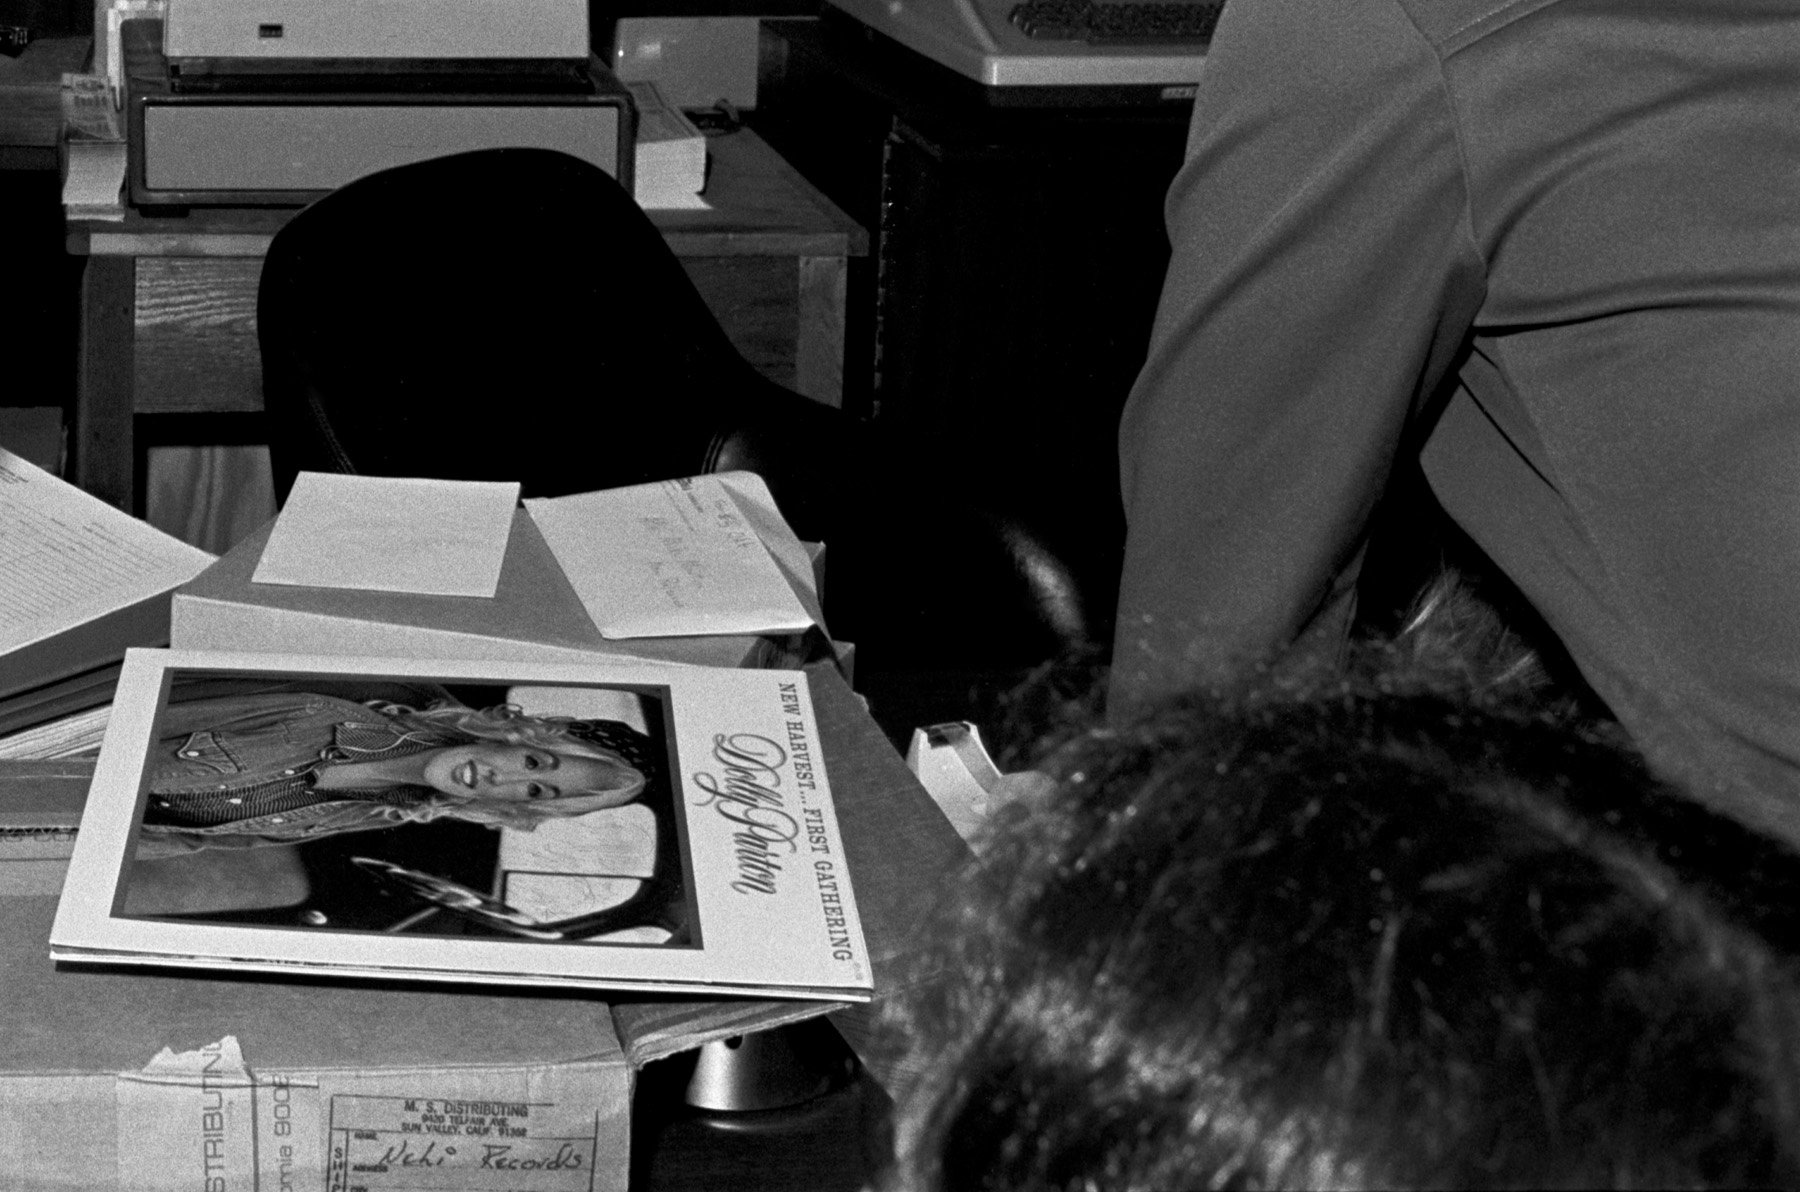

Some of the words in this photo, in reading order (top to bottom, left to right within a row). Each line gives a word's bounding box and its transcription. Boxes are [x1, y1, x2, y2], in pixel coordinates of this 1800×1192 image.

[779, 683, 801, 716] NEW
[693, 732, 787, 809] Dolly
[715, 799, 799, 895] Parton
[804, 809, 830, 854] FIRST
[814, 860, 853, 962] GATHERING
[401, 1122, 421, 1133] SUN
[404, 1101, 419, 1113] M.
[426, 1101, 438, 1114] S.
[444, 1103, 528, 1118] DISTRIBUTING
[480, 1143, 582, 1171] Records
